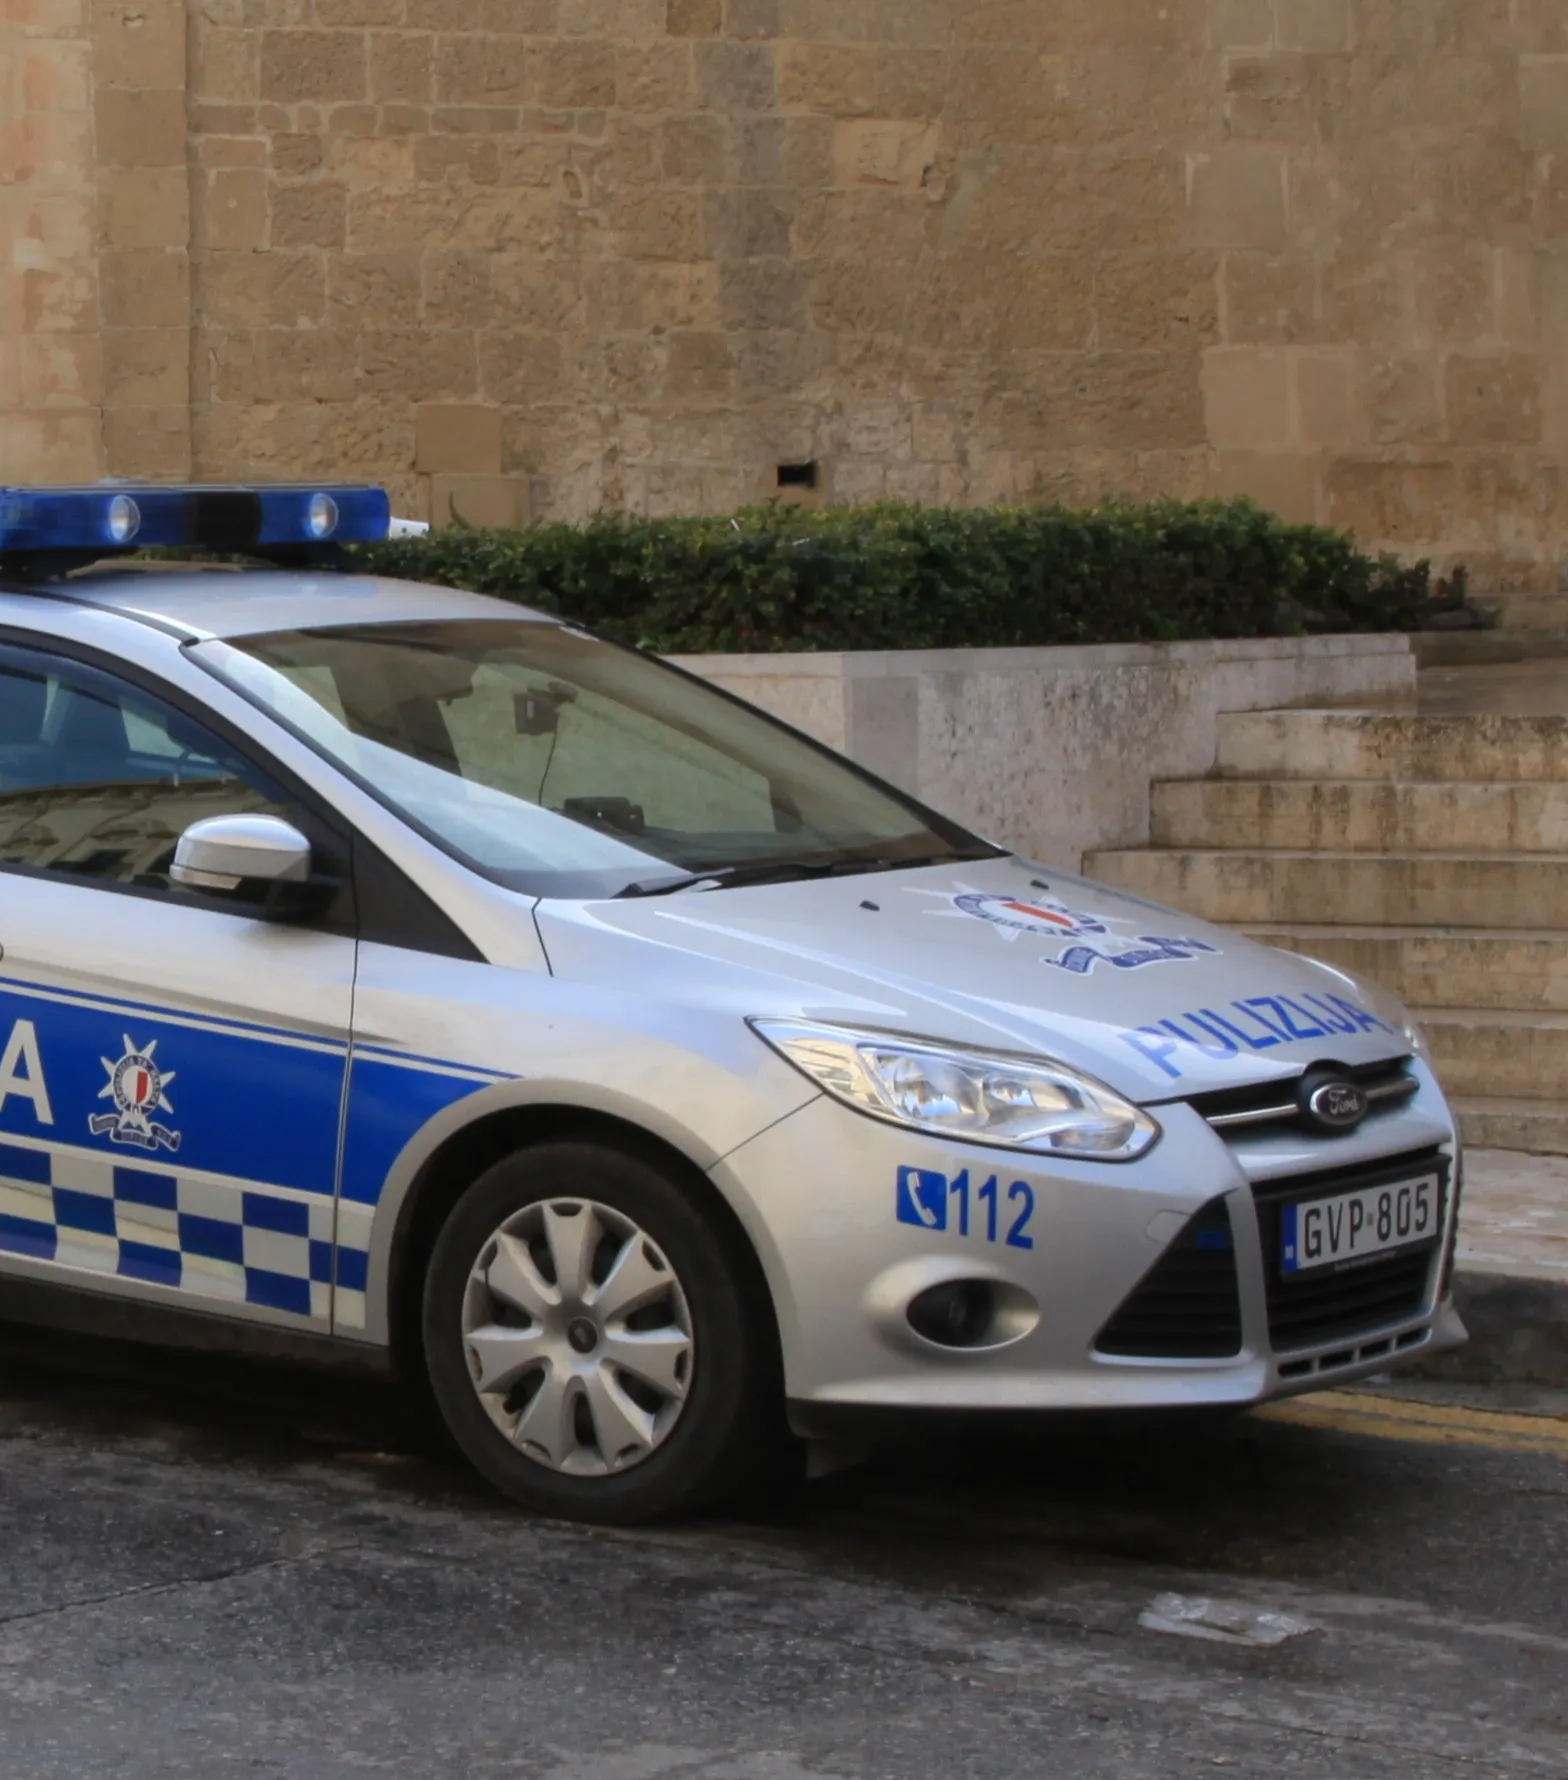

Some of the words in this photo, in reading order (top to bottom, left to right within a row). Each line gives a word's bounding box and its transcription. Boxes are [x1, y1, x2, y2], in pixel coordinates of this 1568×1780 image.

[1116, 992, 1396, 1079] PULIZIJA
[1328, 1089, 1359, 1115] Ford
[948, 1168, 1034, 1250] 112
